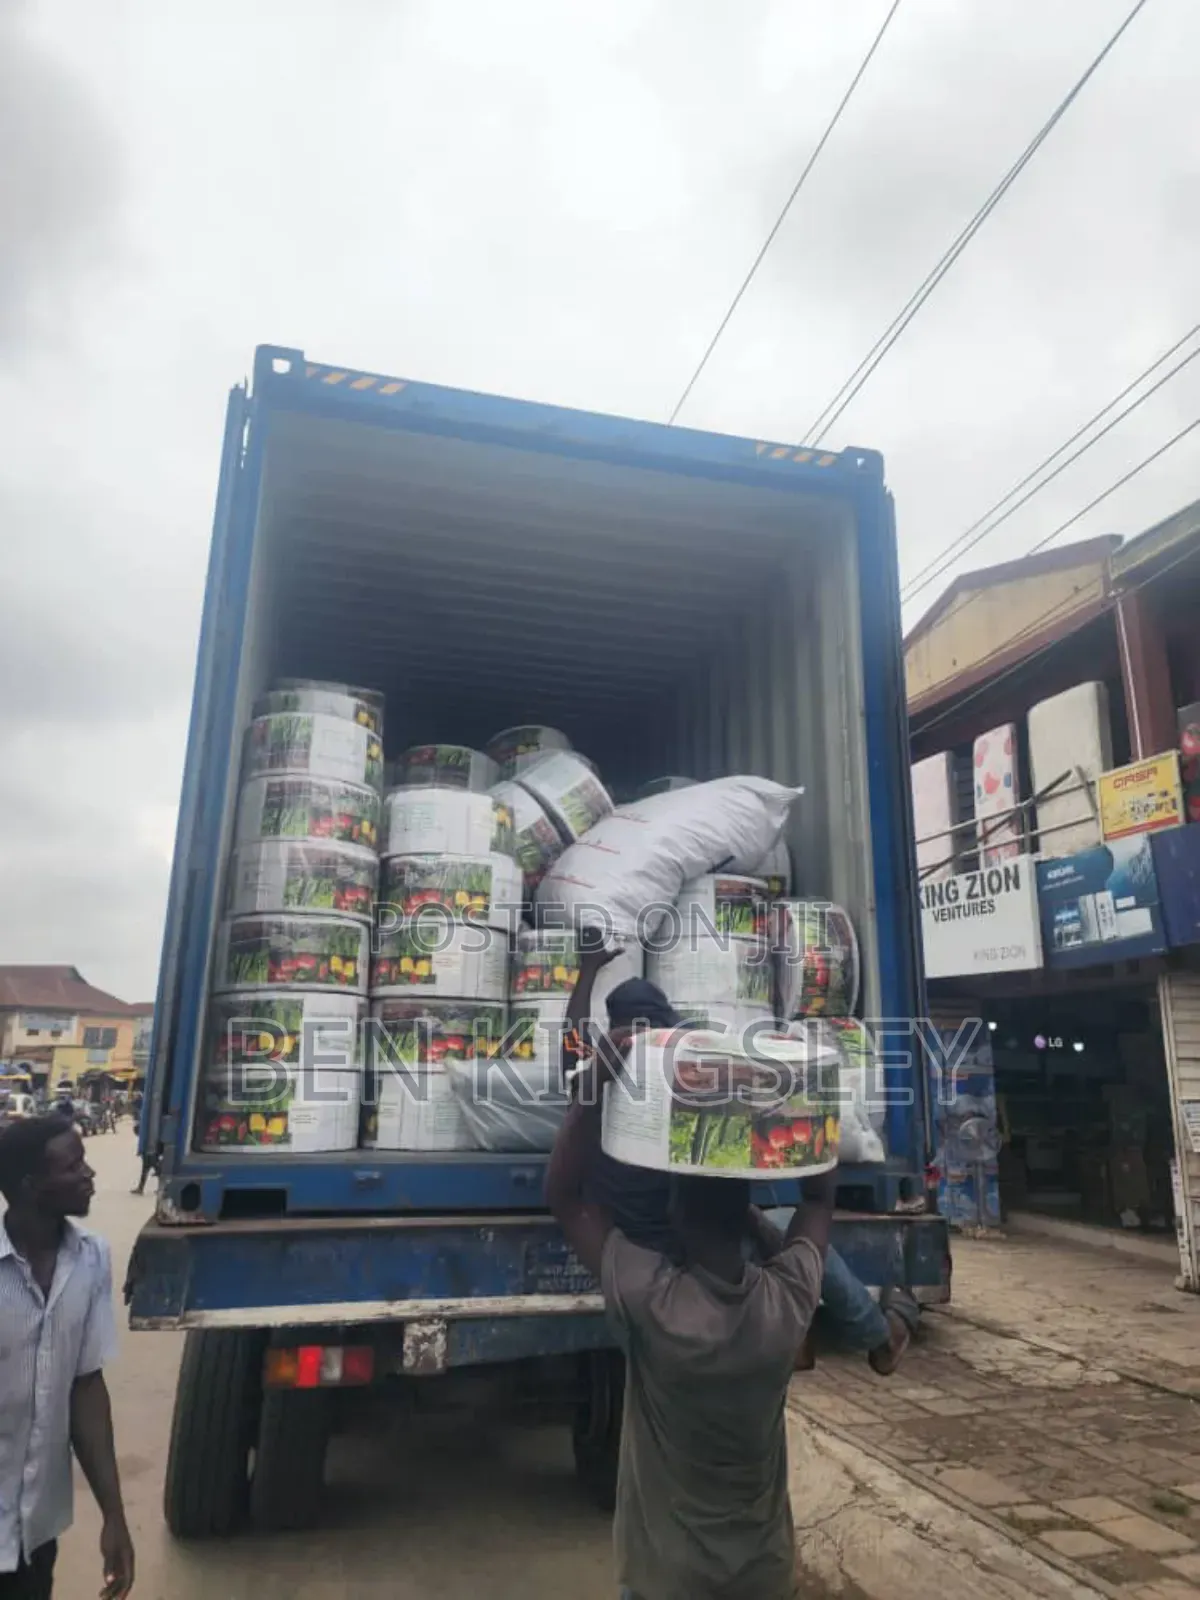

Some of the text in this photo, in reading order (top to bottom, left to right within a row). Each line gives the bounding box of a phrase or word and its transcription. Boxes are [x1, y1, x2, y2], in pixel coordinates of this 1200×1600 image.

[965, 864, 1020, 900] ZION
[932, 899, 996, 922] VENTURES
[1048, 1036, 1063, 1048] LG
